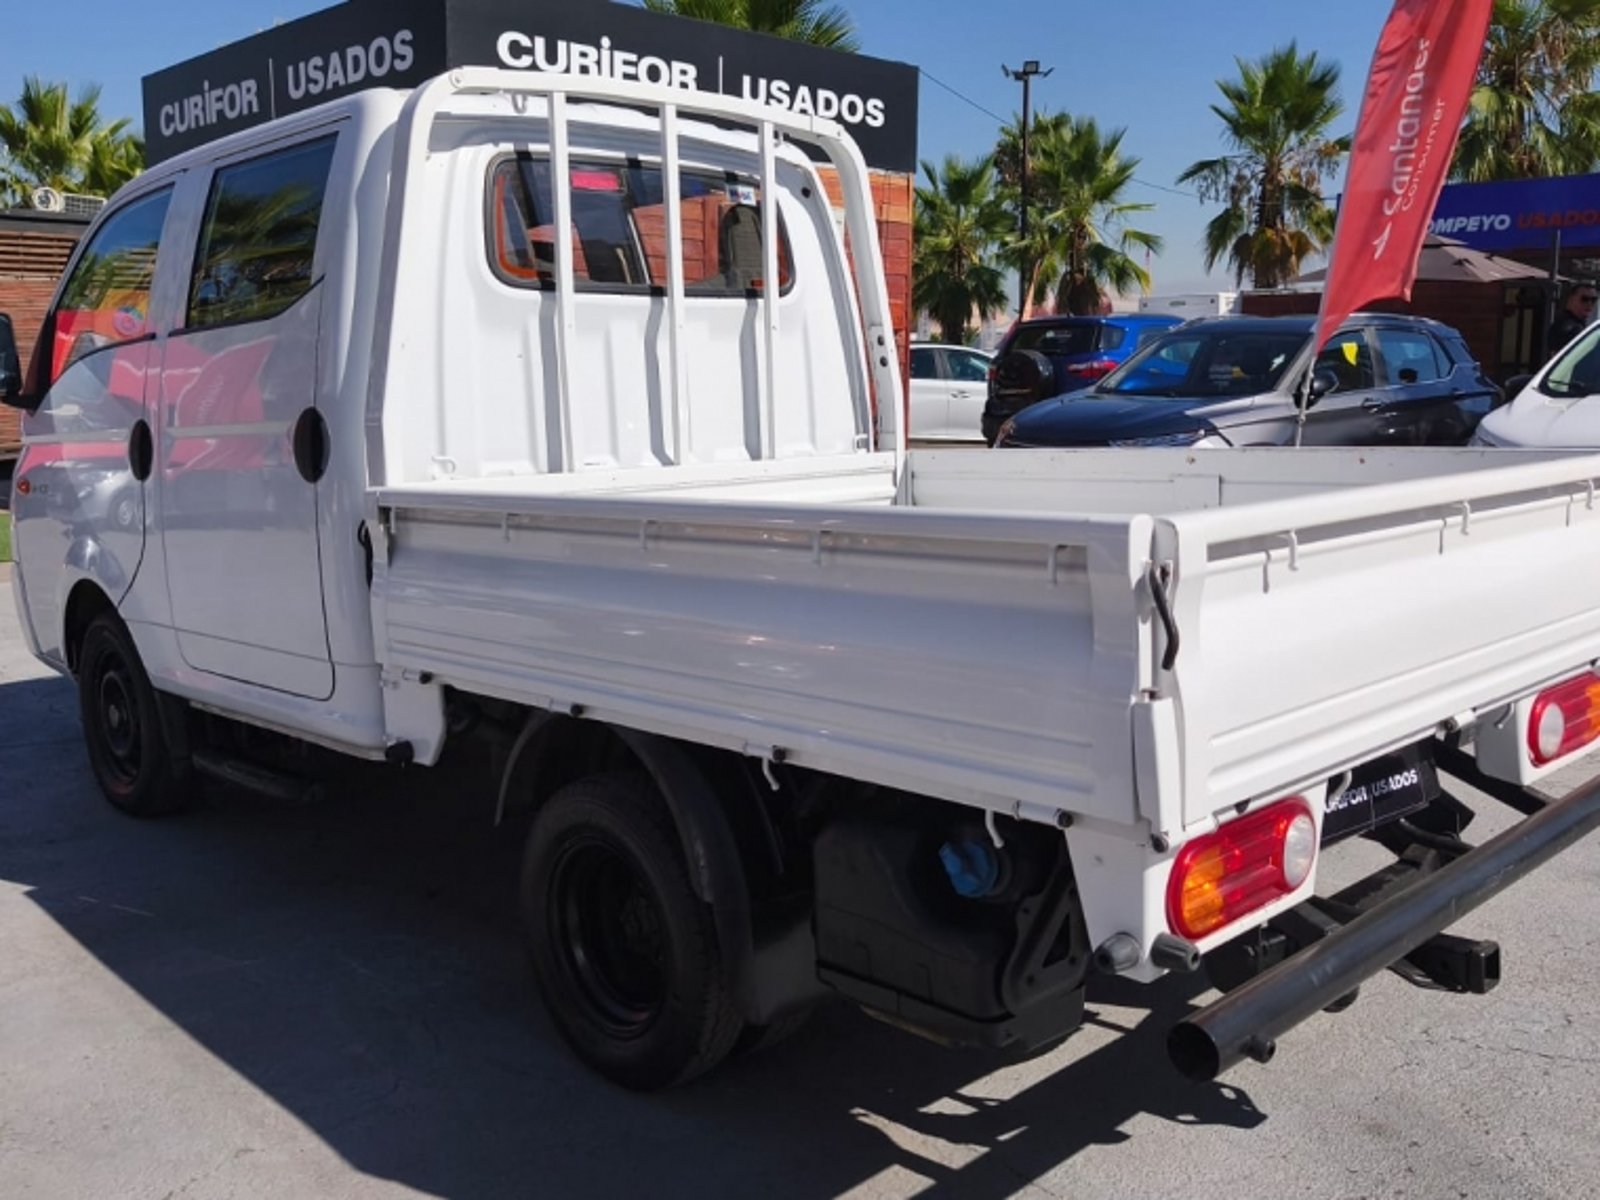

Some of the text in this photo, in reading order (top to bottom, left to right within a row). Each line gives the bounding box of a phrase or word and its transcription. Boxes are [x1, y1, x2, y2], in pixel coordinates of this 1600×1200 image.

[287, 29, 414, 100] USADOS
[742, 74, 885, 127] USADOS
[1382, 37, 1430, 216] Santander
[1401, 97, 1445, 211] Consumer
[1371, 768, 1418, 797] USADOS
